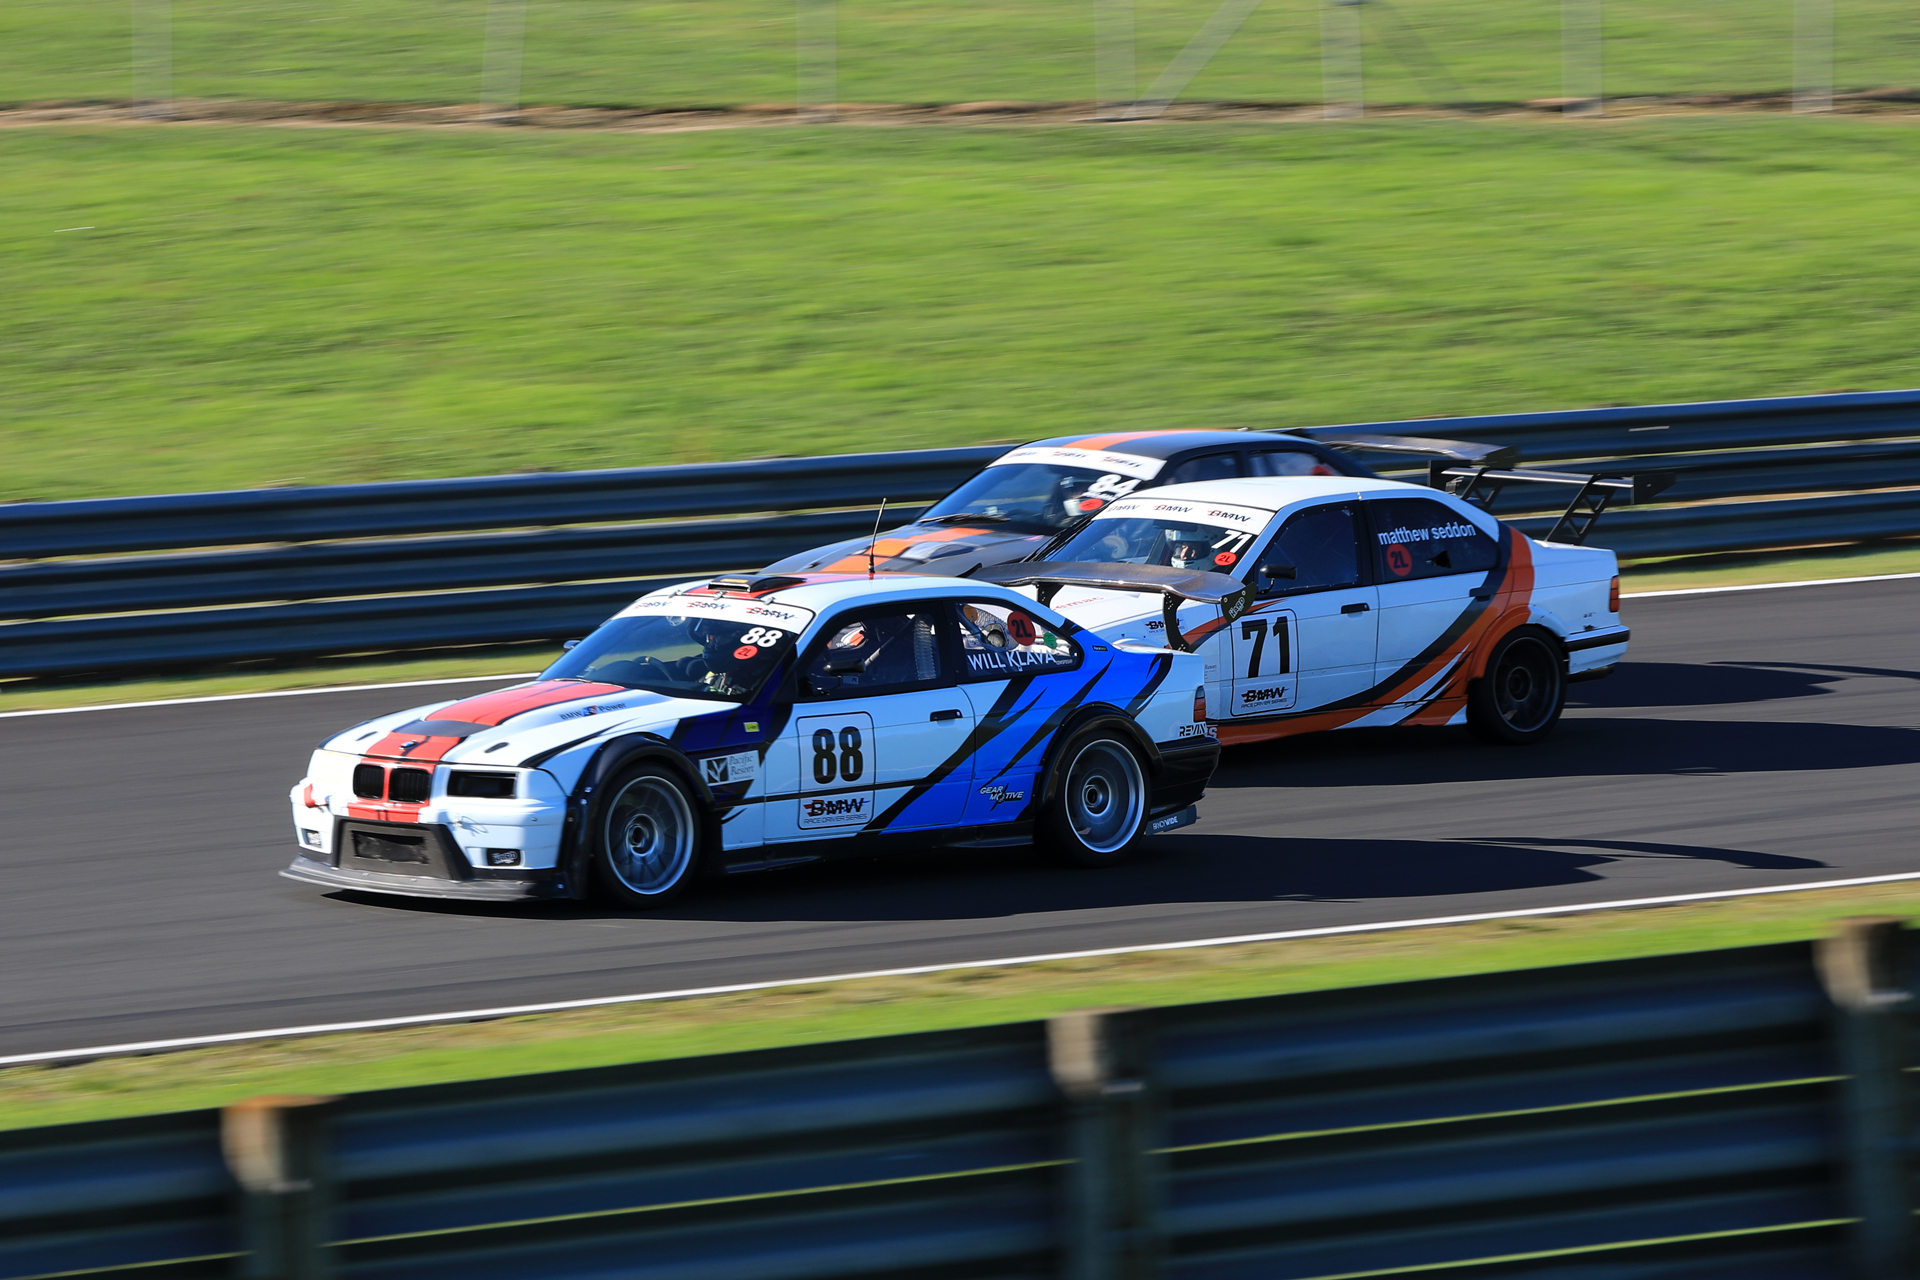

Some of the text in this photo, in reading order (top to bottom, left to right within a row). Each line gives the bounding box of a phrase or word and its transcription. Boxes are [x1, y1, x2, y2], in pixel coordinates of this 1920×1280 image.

[1087, 474, 1142, 498] 84
[1208, 510, 1252, 522] BMW
[1211, 529, 1253, 553] 71
[1378, 522, 1476, 545] matthew seddon
[1218, 554, 1231, 564] 2L
[1390, 551, 1409, 570] 2L
[740, 627, 783, 648] 88
[1011, 619, 1033, 639] 2L
[738, 648, 751, 657] 2L
[1241, 616, 1290, 678] 71
[967, 649, 1057, 671] WILL KLAVA
[1244, 686, 1286, 703] BMW
[598, 702, 627, 712] Power
[729, 755, 754, 766] Pacific
[812, 726, 864, 785] 88
[729, 765, 755, 776] Resort
[980, 786, 1004, 795] GEAR
[810, 798, 865, 817] BMW
[821, 815, 845, 823] DRIVER
[845, 813, 868, 821] SERIES
